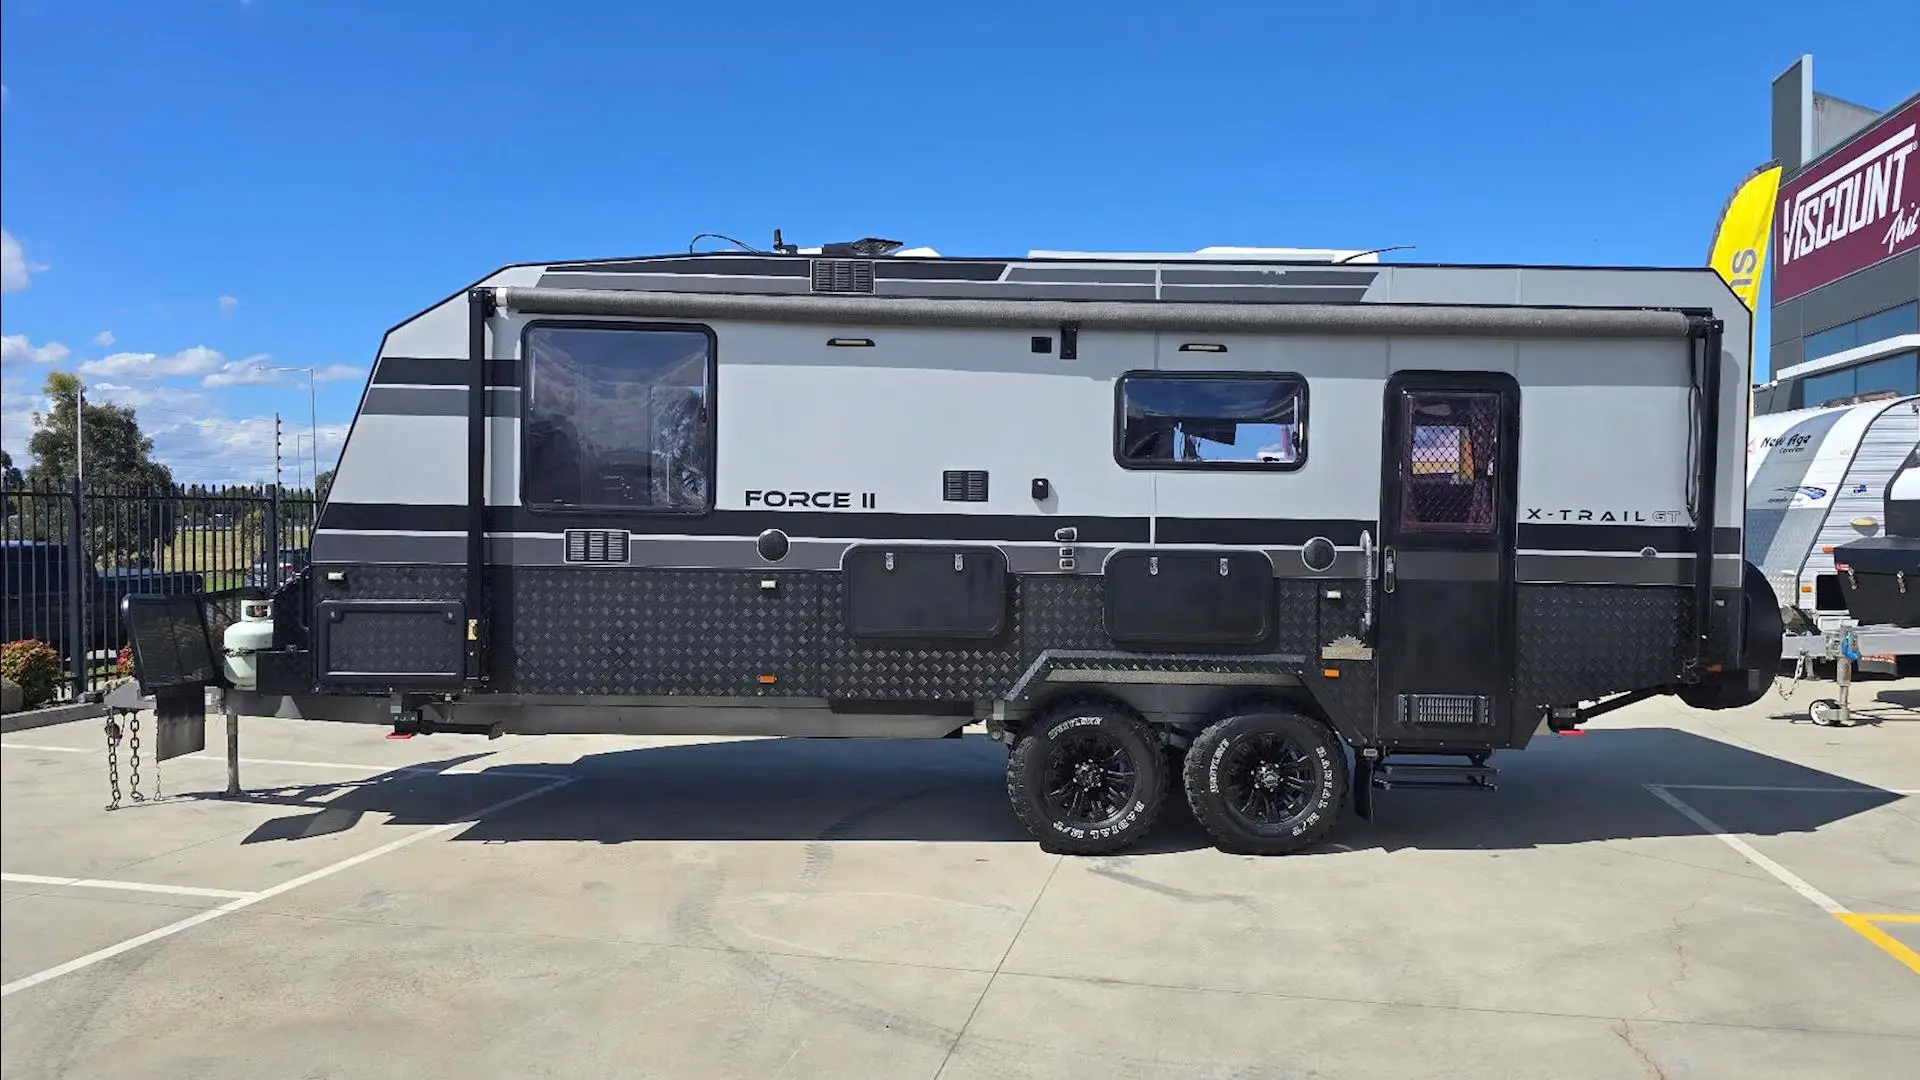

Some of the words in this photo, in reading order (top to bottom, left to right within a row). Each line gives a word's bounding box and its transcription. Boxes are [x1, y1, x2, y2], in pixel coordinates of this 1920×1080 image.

[1783, 124, 1916, 266] VISCOUNT
[1761, 436, 1786, 448] New
[1787, 433, 1812, 447] Age
[745, 490, 851, 508] FORCE
[862, 492, 876, 509] II
[1527, 508, 1646, 522] X-TRAIL
[1087, 800, 1145, 839] RADIAL
